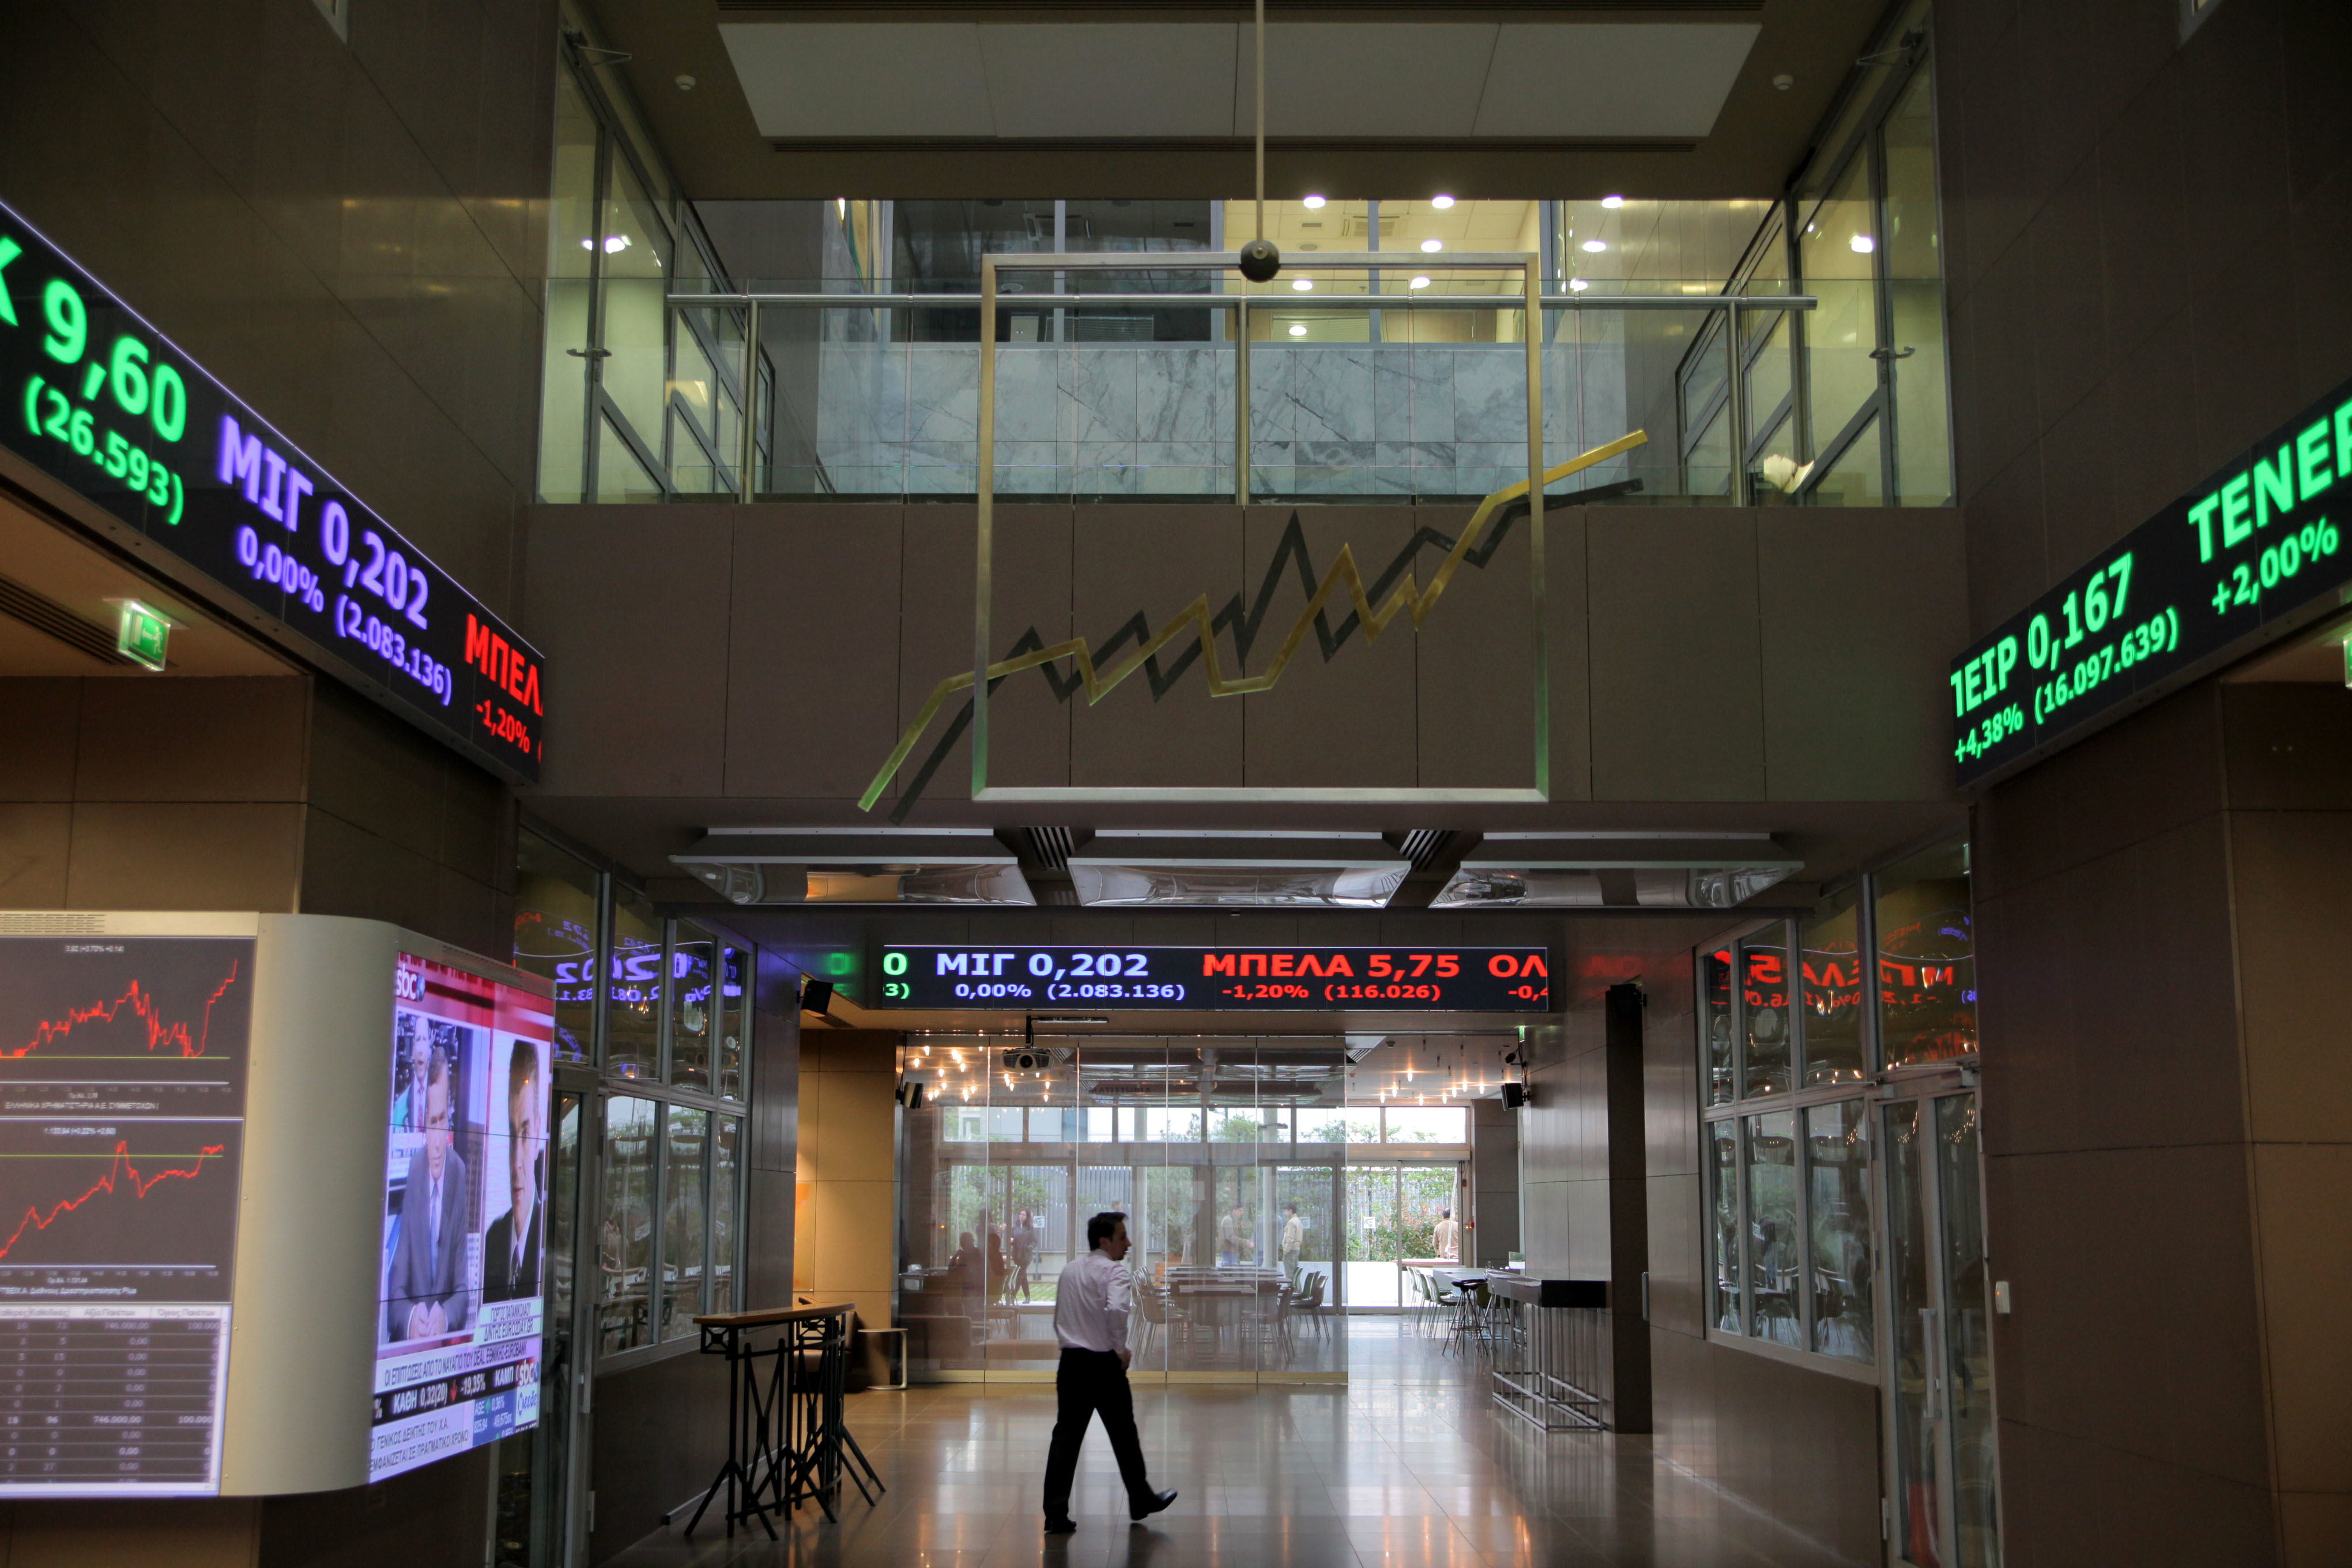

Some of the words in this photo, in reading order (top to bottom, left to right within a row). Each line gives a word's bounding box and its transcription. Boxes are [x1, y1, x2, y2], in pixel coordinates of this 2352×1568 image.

[43, 278, 187, 443] 9,60
[24, 375, 184, 526] (26.593)
[216, 413, 315, 533] ΜΙΓ
[319, 499, 429, 631] 0,202
[236, 524, 326, 613] 0,00%
[334, 593, 453, 707] (2.083.136)
[1954, 702, 2025, 764] +4,38%
[2034, 606, 2179, 725] (16.097.639)
[2211, 517, 2339, 615] +2,00%
[2027, 551, 2134, 670] 0,167
[476, 699, 531, 754] -1,20%
[396, 963, 417, 1000] sbc
[936, 953, 1016, 977] ΜΙΓ
[1028, 953, 1149, 982] 0,202
[1203, 953, 1354, 977] ΜΠΕΛΑ
[1368, 954, 1460, 982] 5,75
[954, 983, 1032, 1000] 0,00%
[1046, 983, 1186, 1001] (2.083.136)
[1222, 984, 1310, 1001] -1,20%
[1324, 984, 1442, 1001] (116.026)
[393, 1389, 418, 1415] ΚΑΘΗ
